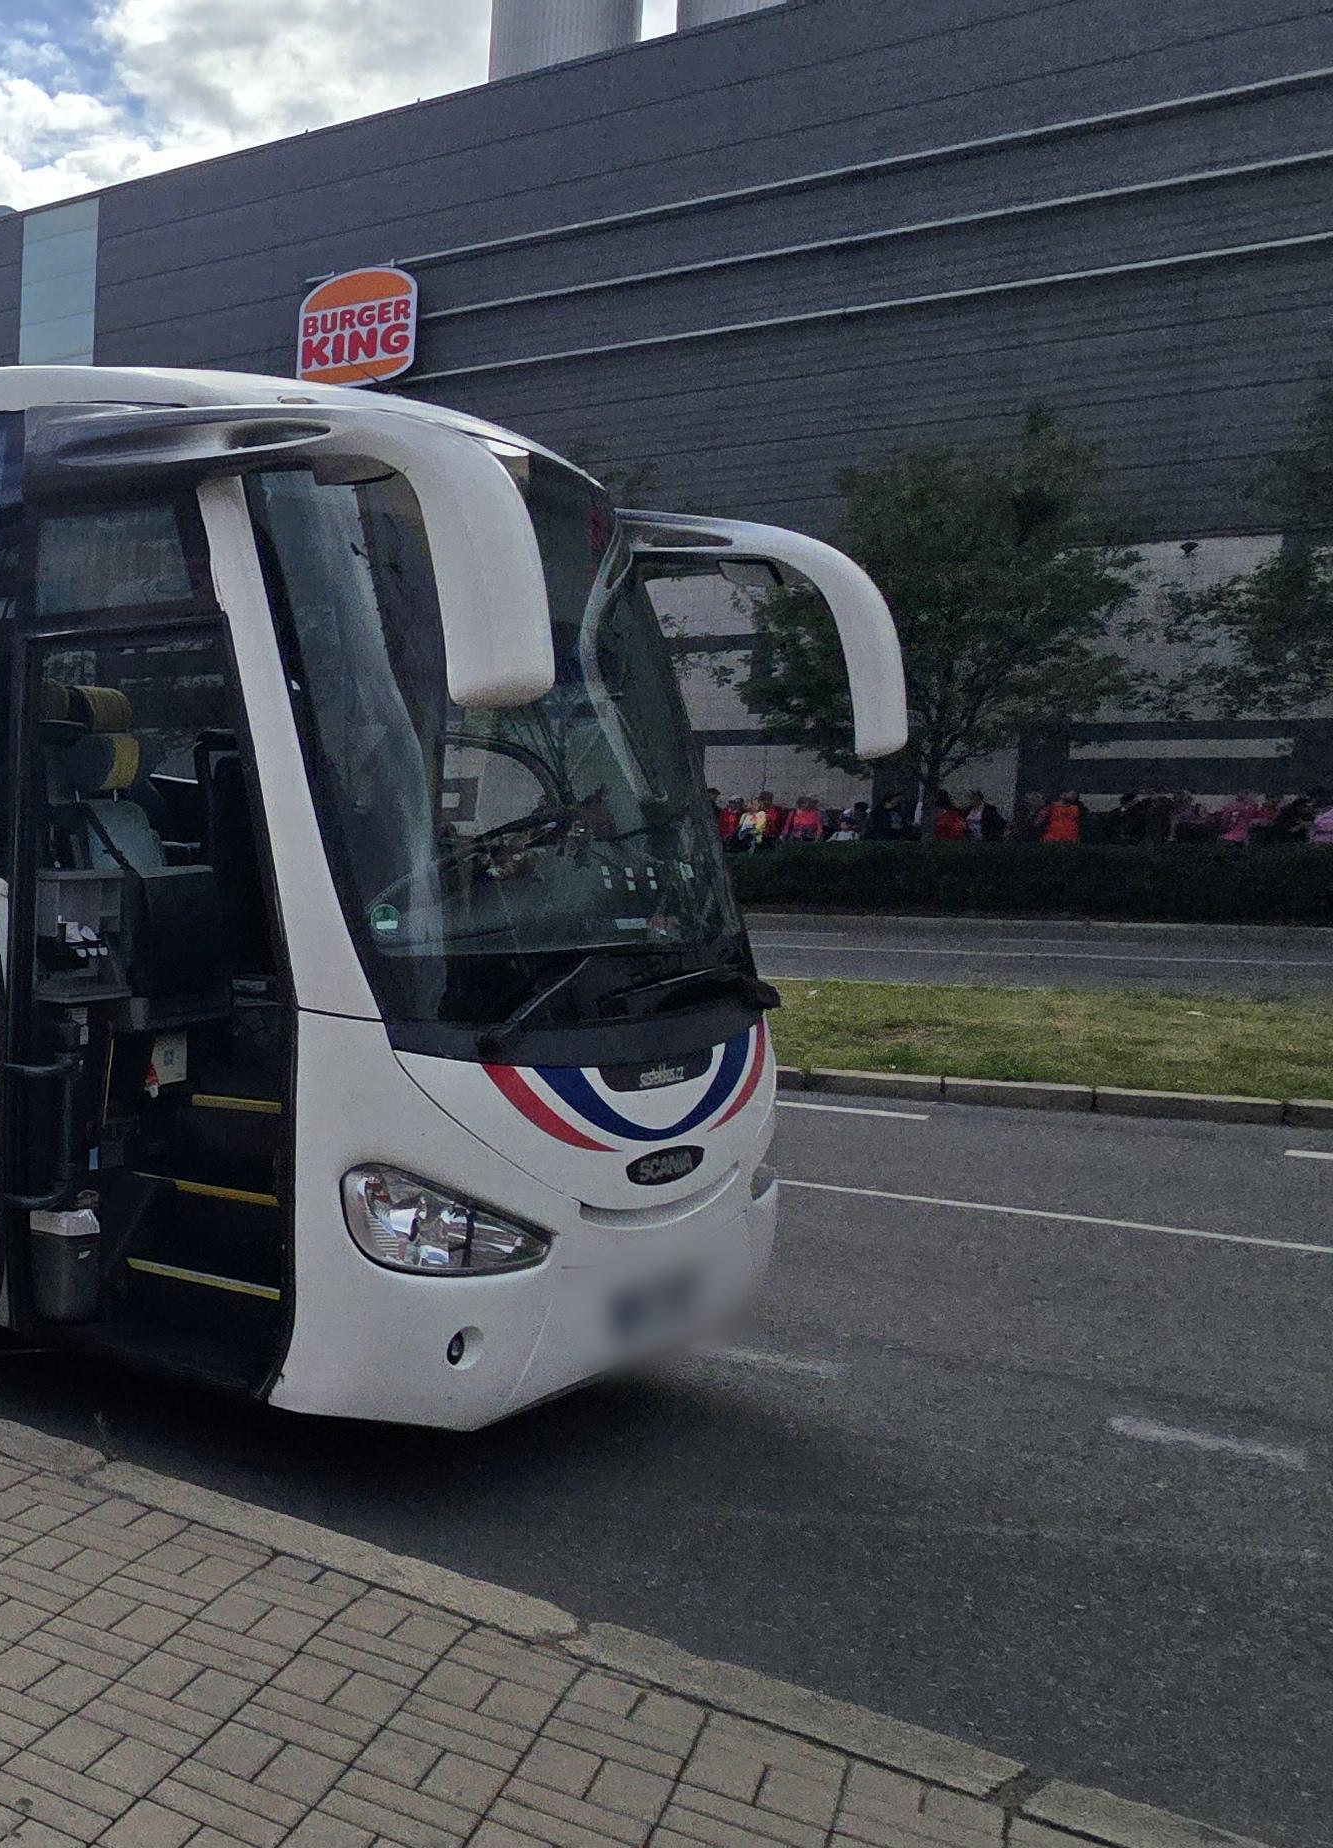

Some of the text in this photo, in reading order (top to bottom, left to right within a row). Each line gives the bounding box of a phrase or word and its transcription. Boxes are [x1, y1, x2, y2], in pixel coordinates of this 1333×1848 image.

[302, 299, 411, 338] BURGER
[301, 323, 410, 369] KING
[637, 1151, 693, 1182] SCANIA
